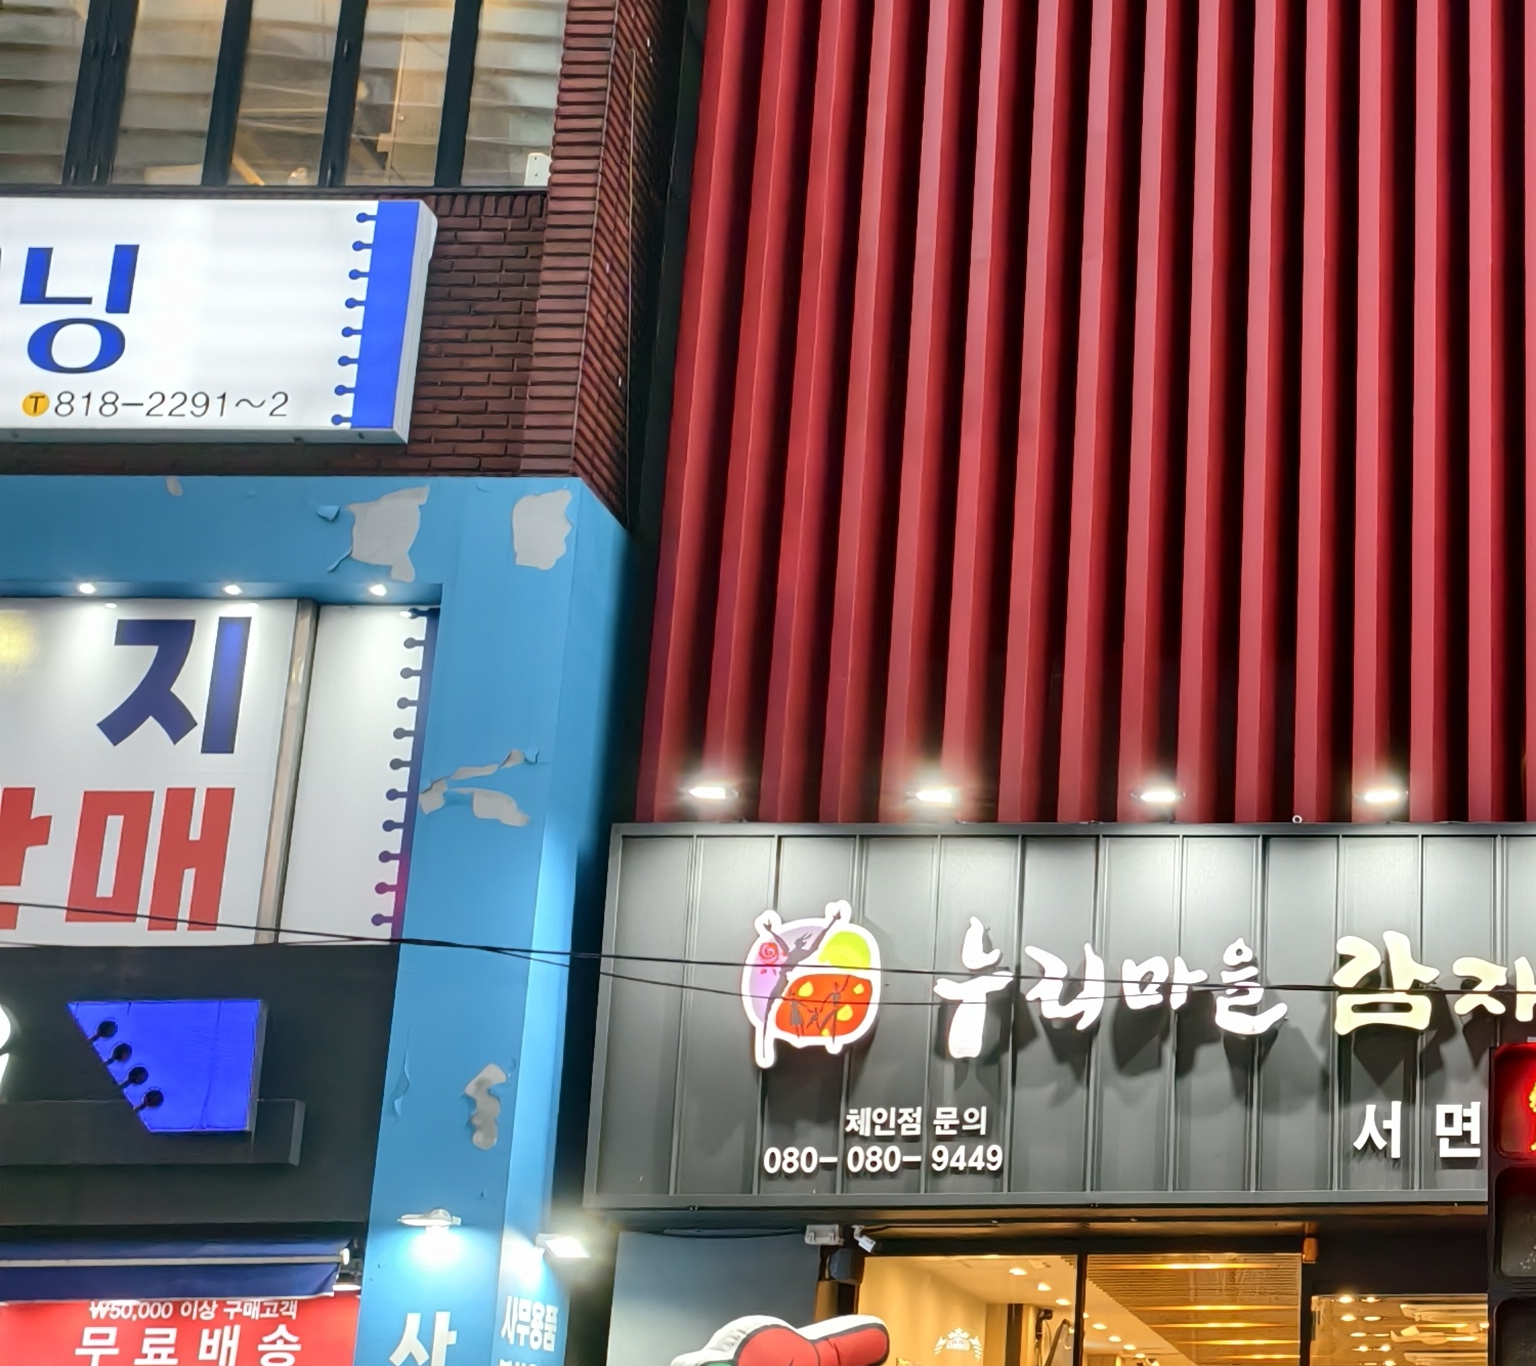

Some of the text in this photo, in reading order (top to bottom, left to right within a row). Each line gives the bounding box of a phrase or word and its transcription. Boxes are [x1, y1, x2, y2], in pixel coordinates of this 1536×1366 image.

[19, 243, 140, 375] 닝
[96, 615, 253, 755] 지
[933, 915, 1289, 1059] 누리마을
[845, 1105, 989, 1138] 체인점 문의
[179, 1299, 218, 1321] 이상
[223, 1298, 299, 1321] 구매고객
[500, 1294, 559, 1353] 사무용품
